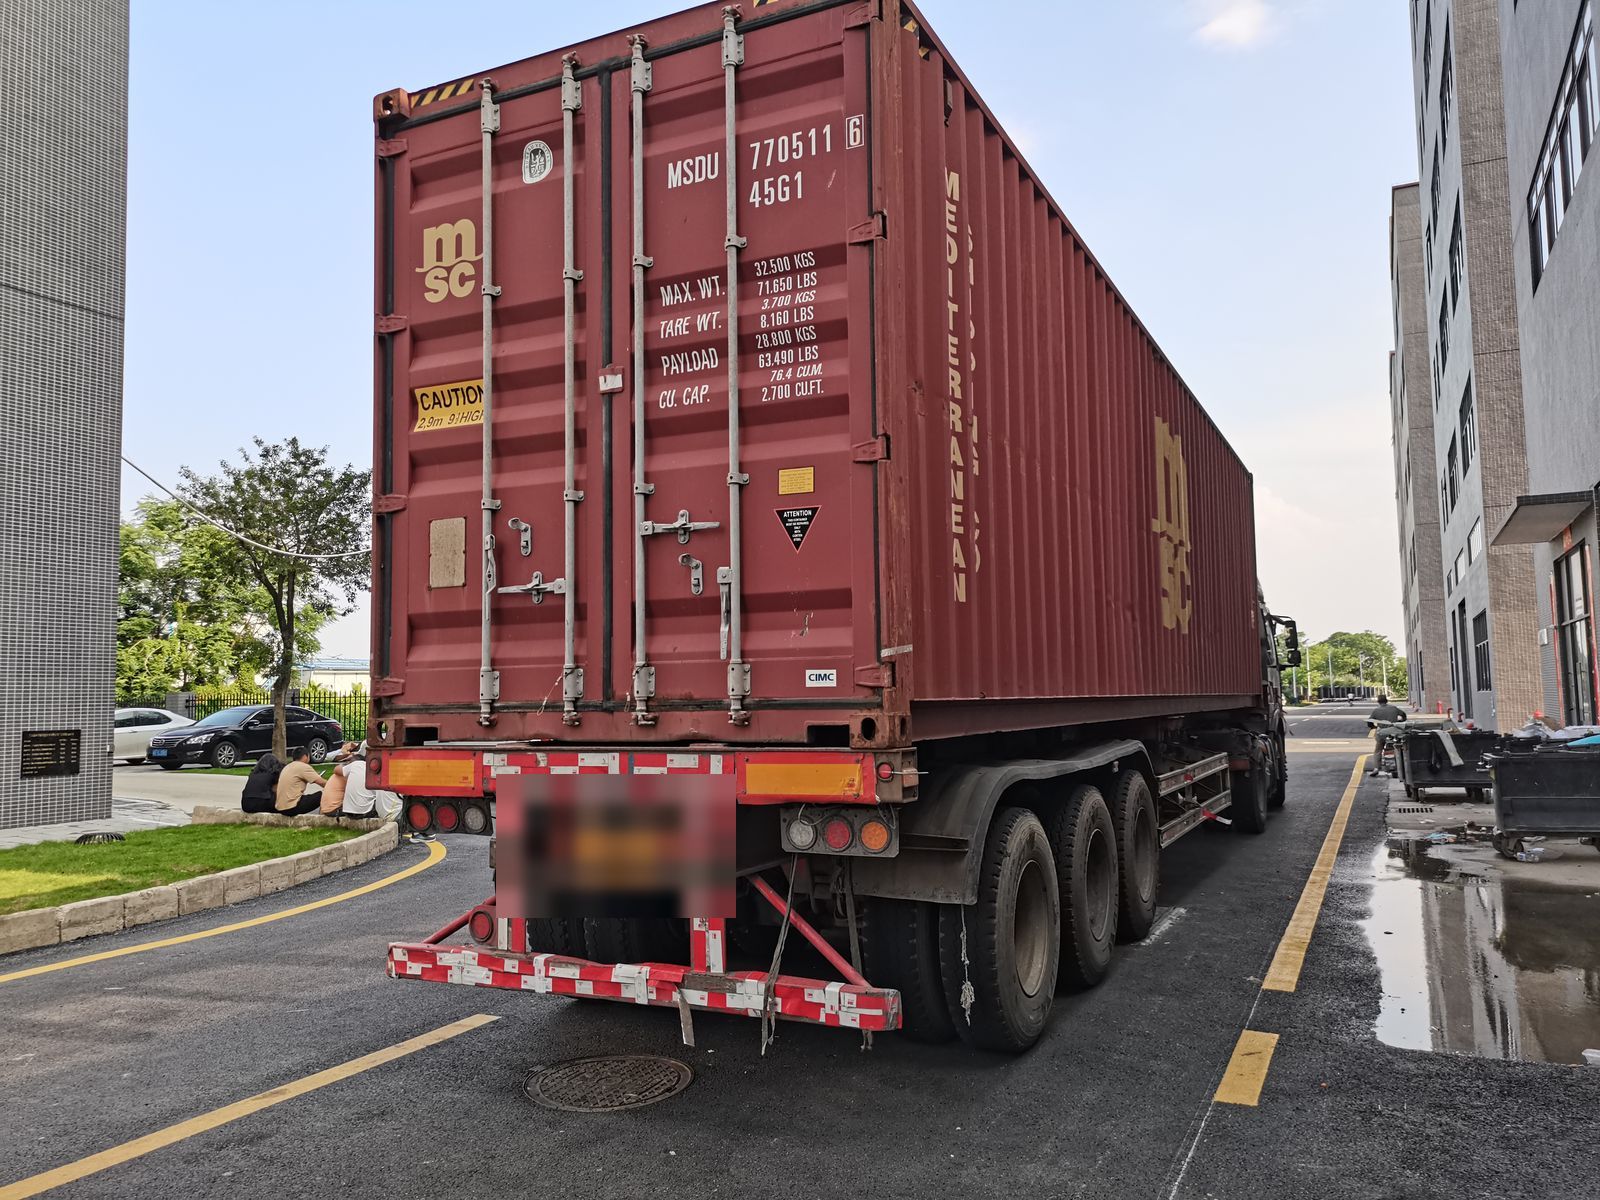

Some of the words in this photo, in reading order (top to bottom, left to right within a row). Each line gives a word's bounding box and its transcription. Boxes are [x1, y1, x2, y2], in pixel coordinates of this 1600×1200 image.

[667, 152, 719, 189] MSDU
[750, 124, 831, 170] 770511
[849, 117, 860, 146] 6
[750, 171, 803, 208] 45G1
[660, 281, 696, 307] MAX.
[697, 275, 726, 299] WT.
[794, 251, 816, 269] KGS
[797, 271, 817, 289] LBS
[660, 316, 691, 339] TARE
[697, 311, 722, 332] WT.
[794, 290, 817, 304] KGS
[794, 305, 814, 323] LBS
[661, 347, 719, 377] PAYLOAD
[795, 325, 817, 343] KGS
[798, 345, 819, 362] LBS
[659, 389, 677, 409] CU.
[682, 384, 710, 406] CAP.
[770, 367, 793, 382] 76.4
[783, 509, 812, 518] ATTENTION
[808, 673, 835, 682] CIMC
